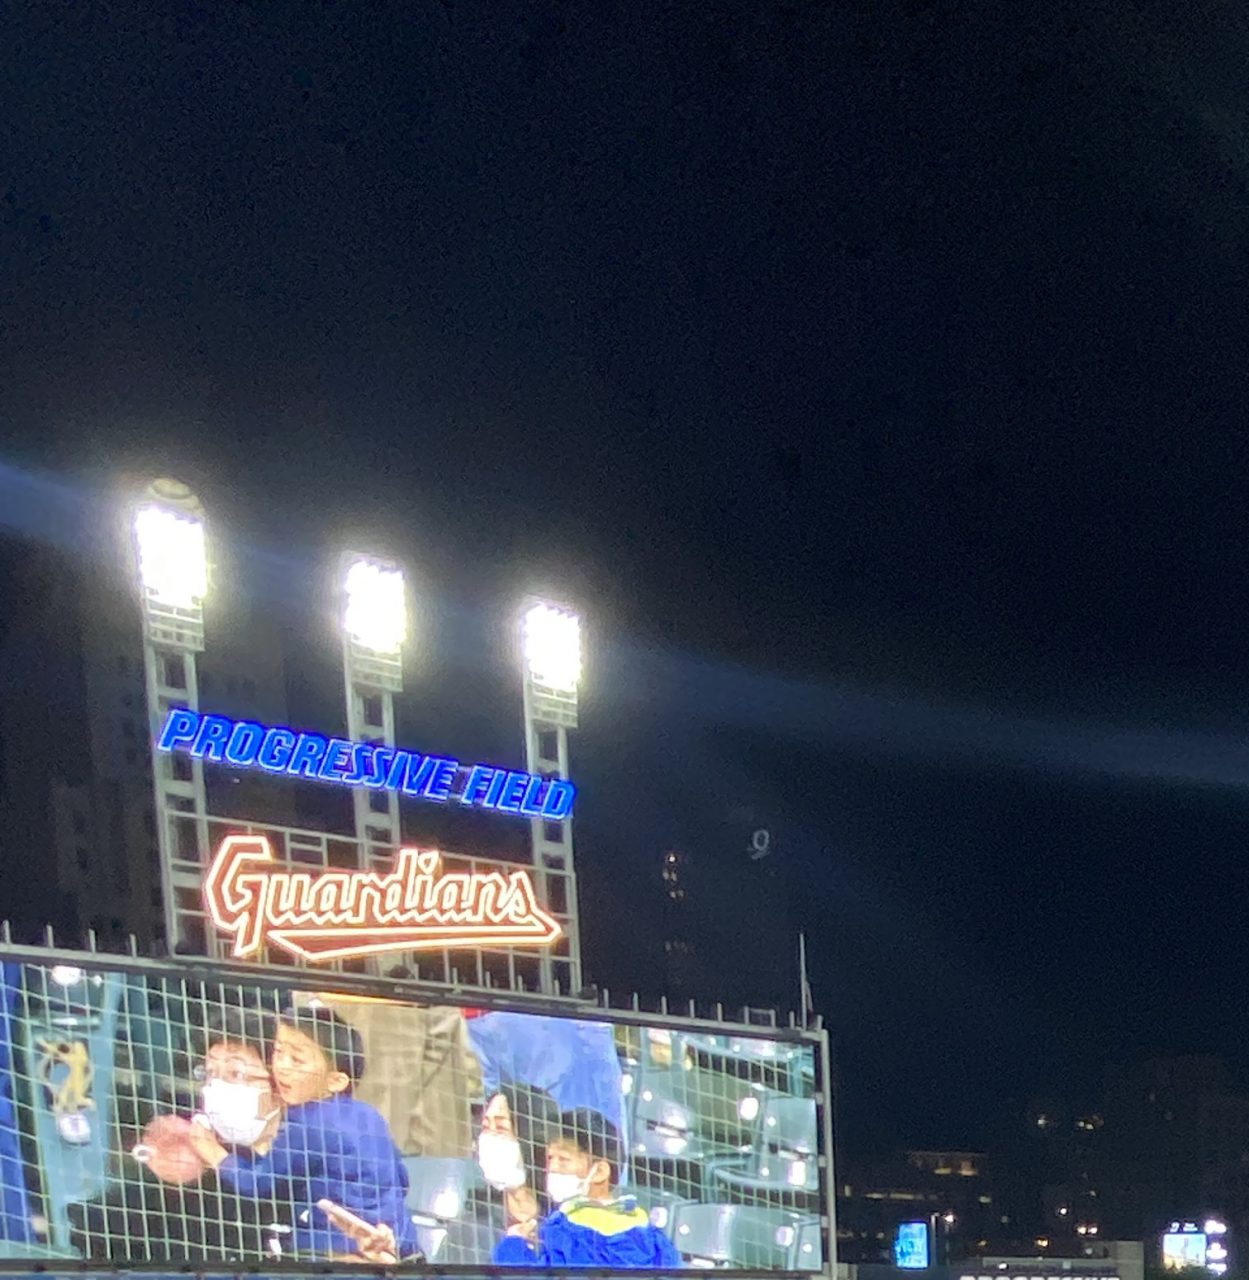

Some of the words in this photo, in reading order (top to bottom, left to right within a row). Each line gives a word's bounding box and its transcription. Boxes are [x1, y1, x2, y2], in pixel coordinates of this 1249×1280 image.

[159, 708, 458, 801] PROGRESSIVE
[462, 764, 578, 821] FIELD
[205, 834, 563, 960] Guardians
